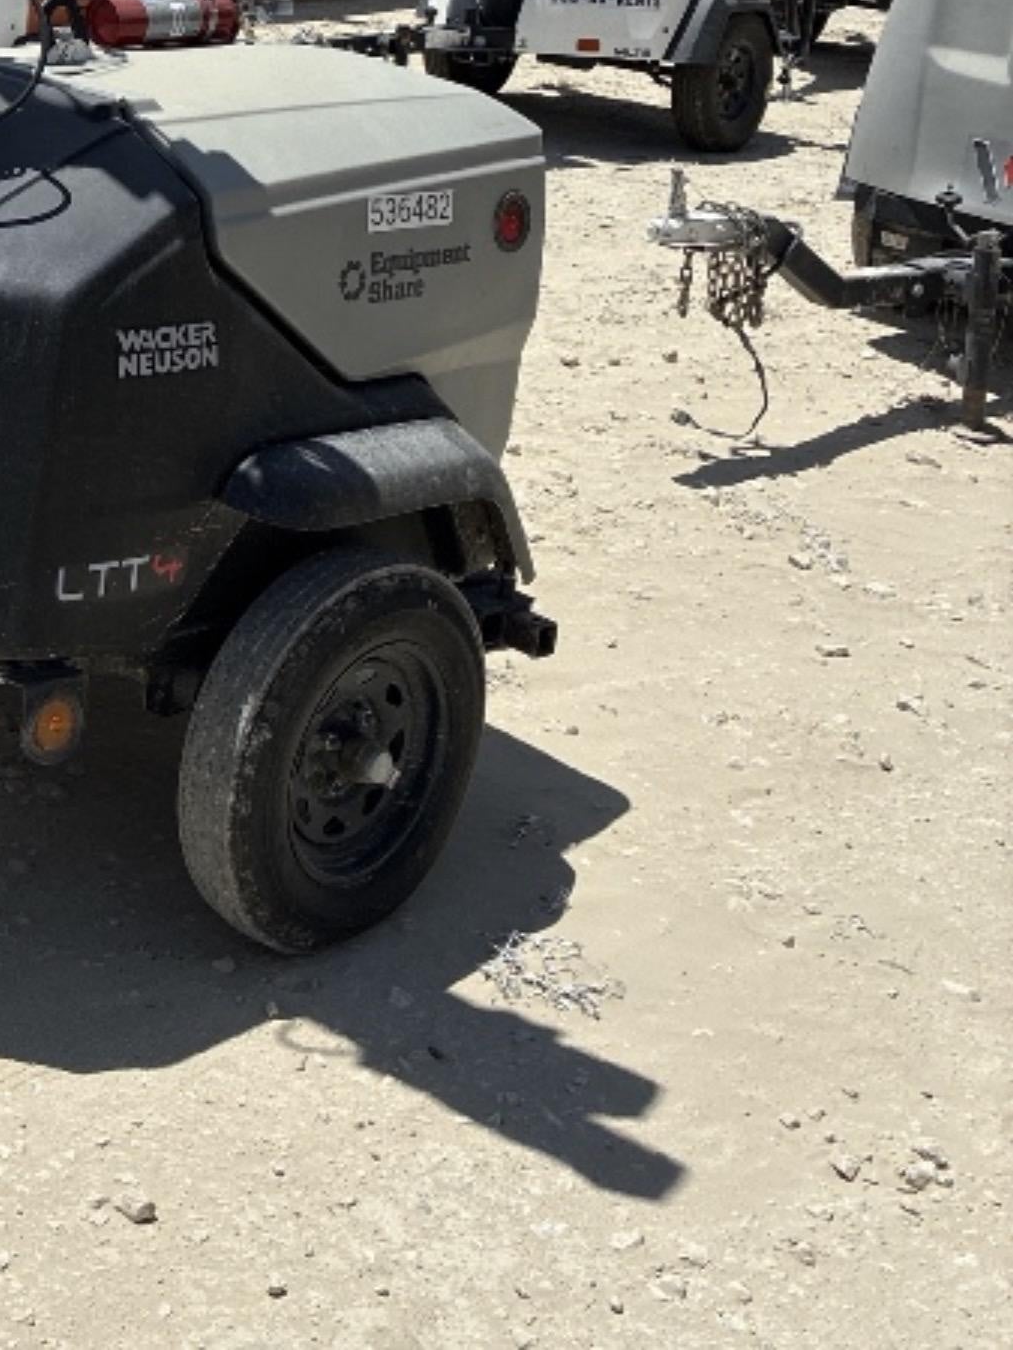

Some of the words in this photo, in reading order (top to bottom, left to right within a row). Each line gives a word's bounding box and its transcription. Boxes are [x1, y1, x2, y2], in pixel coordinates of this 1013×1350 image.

[370, 194, 451, 226] 536482
[370, 244, 471, 278] Equipment
[368, 278, 425, 303] Share
[116, 321, 217, 352] WACKER
[118, 345, 219, 378] NEUSON
